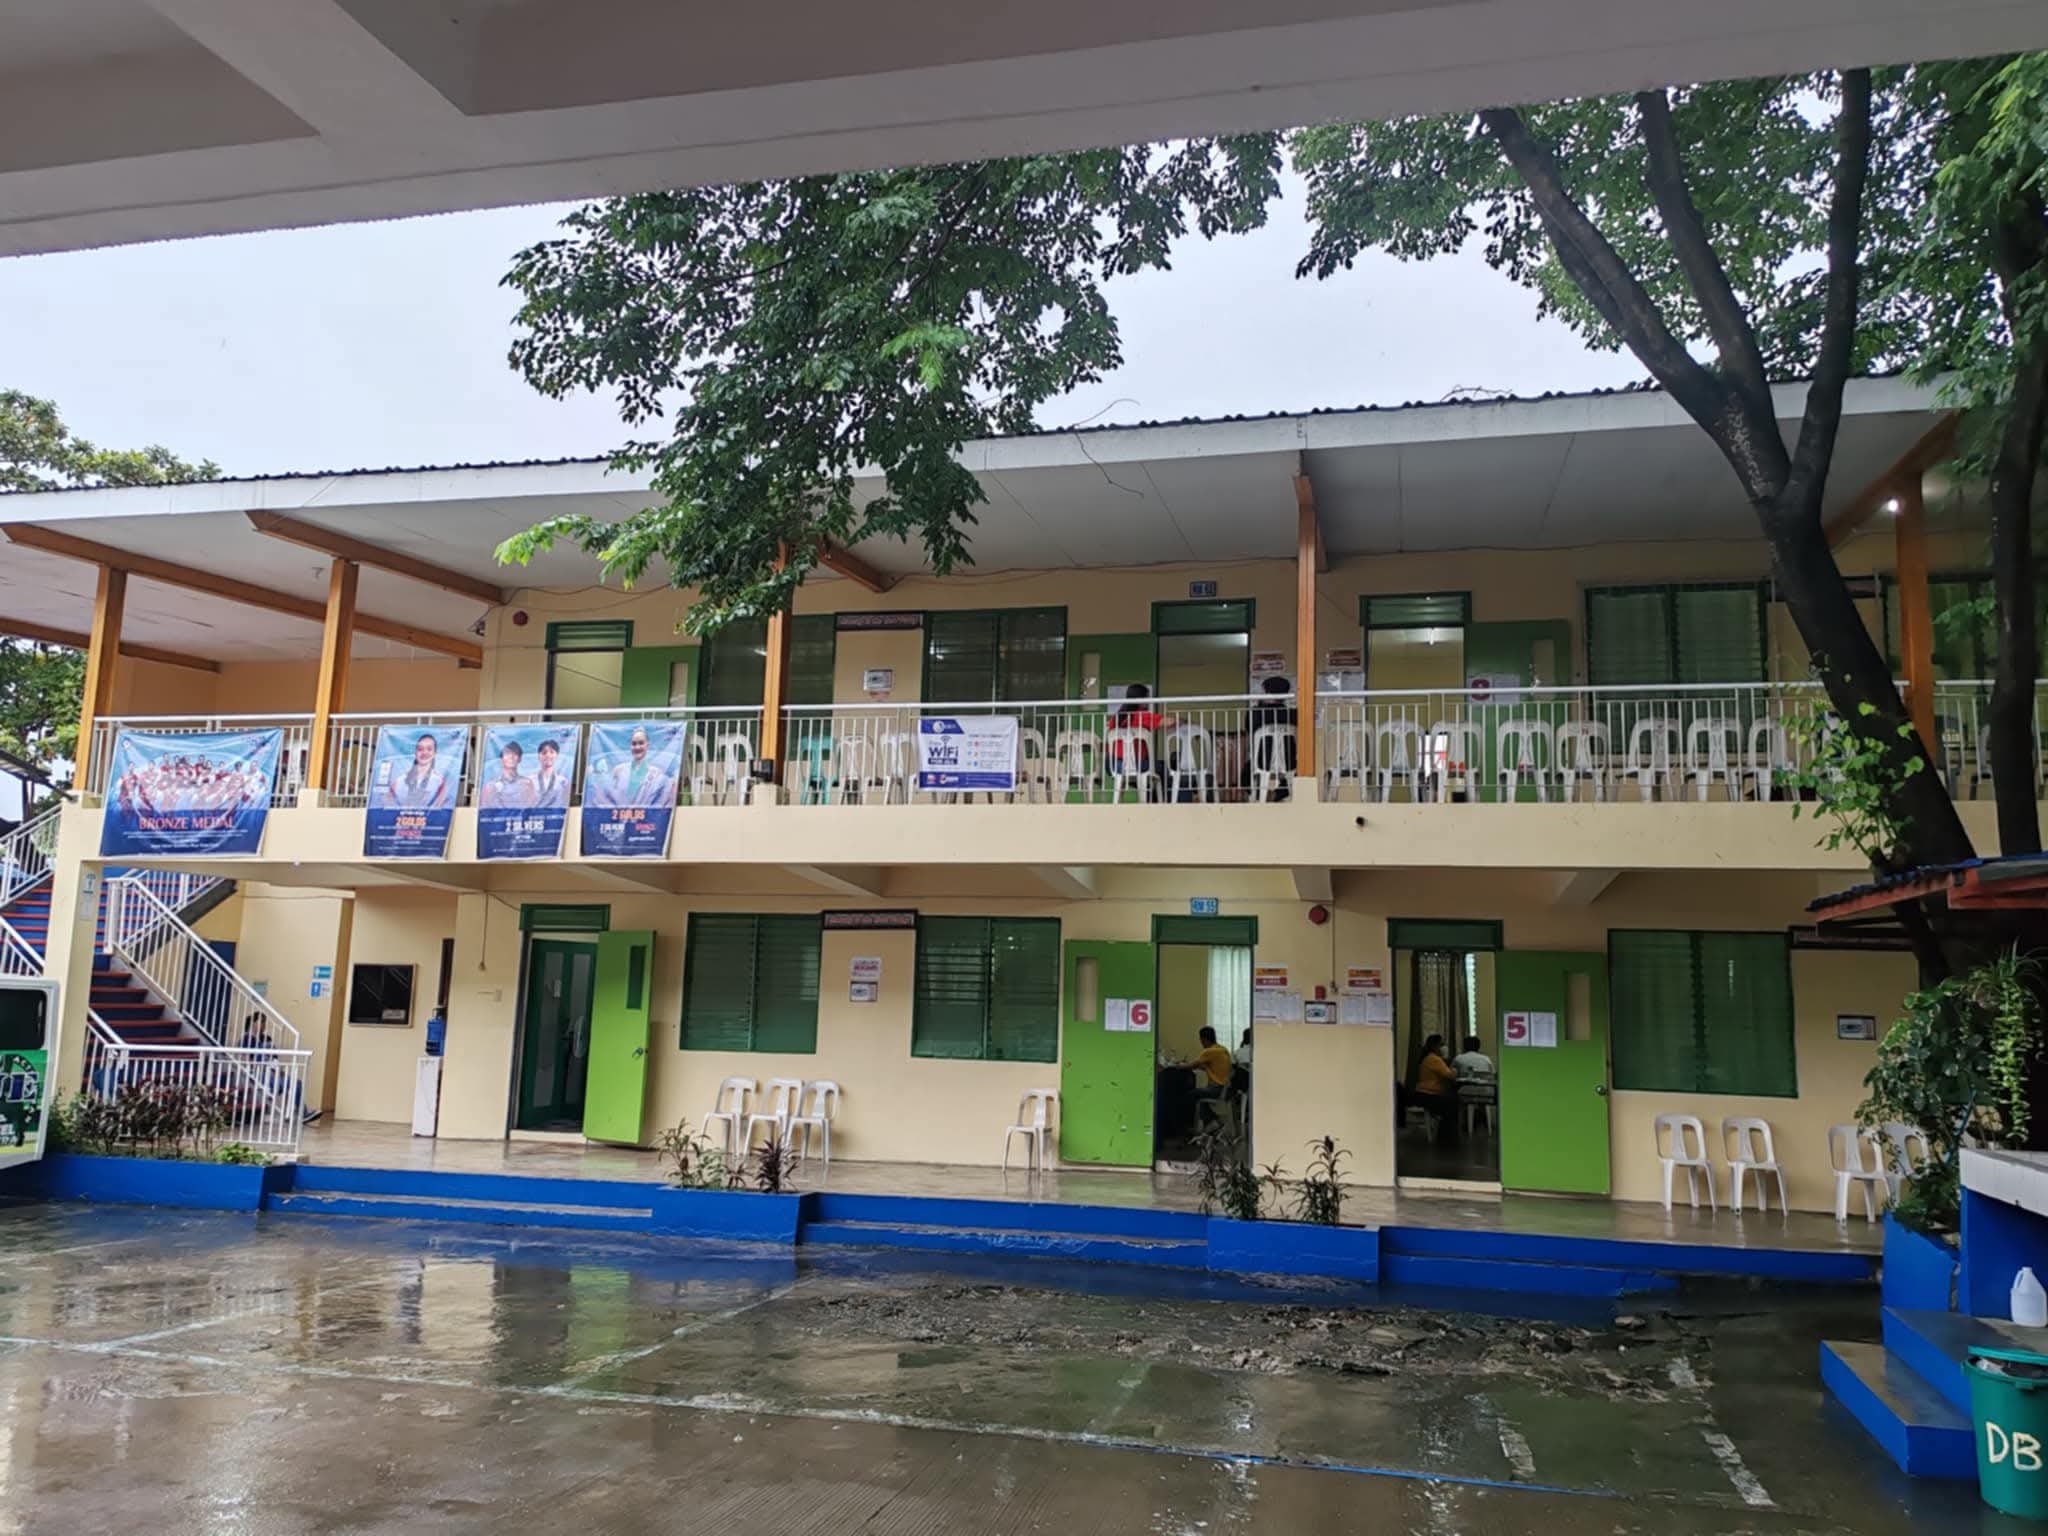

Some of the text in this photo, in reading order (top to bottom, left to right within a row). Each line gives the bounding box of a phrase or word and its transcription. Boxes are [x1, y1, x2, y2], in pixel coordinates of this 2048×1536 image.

[928, 745, 959, 757] WiFi
[139, 816, 234, 830] BRONZE MEDAL
[512, 820, 545, 833] SILVERS
[1131, 1004, 1149, 1025] 6
[1507, 1015, 1527, 1039] 5
[1985, 1421, 2043, 1471] DB
